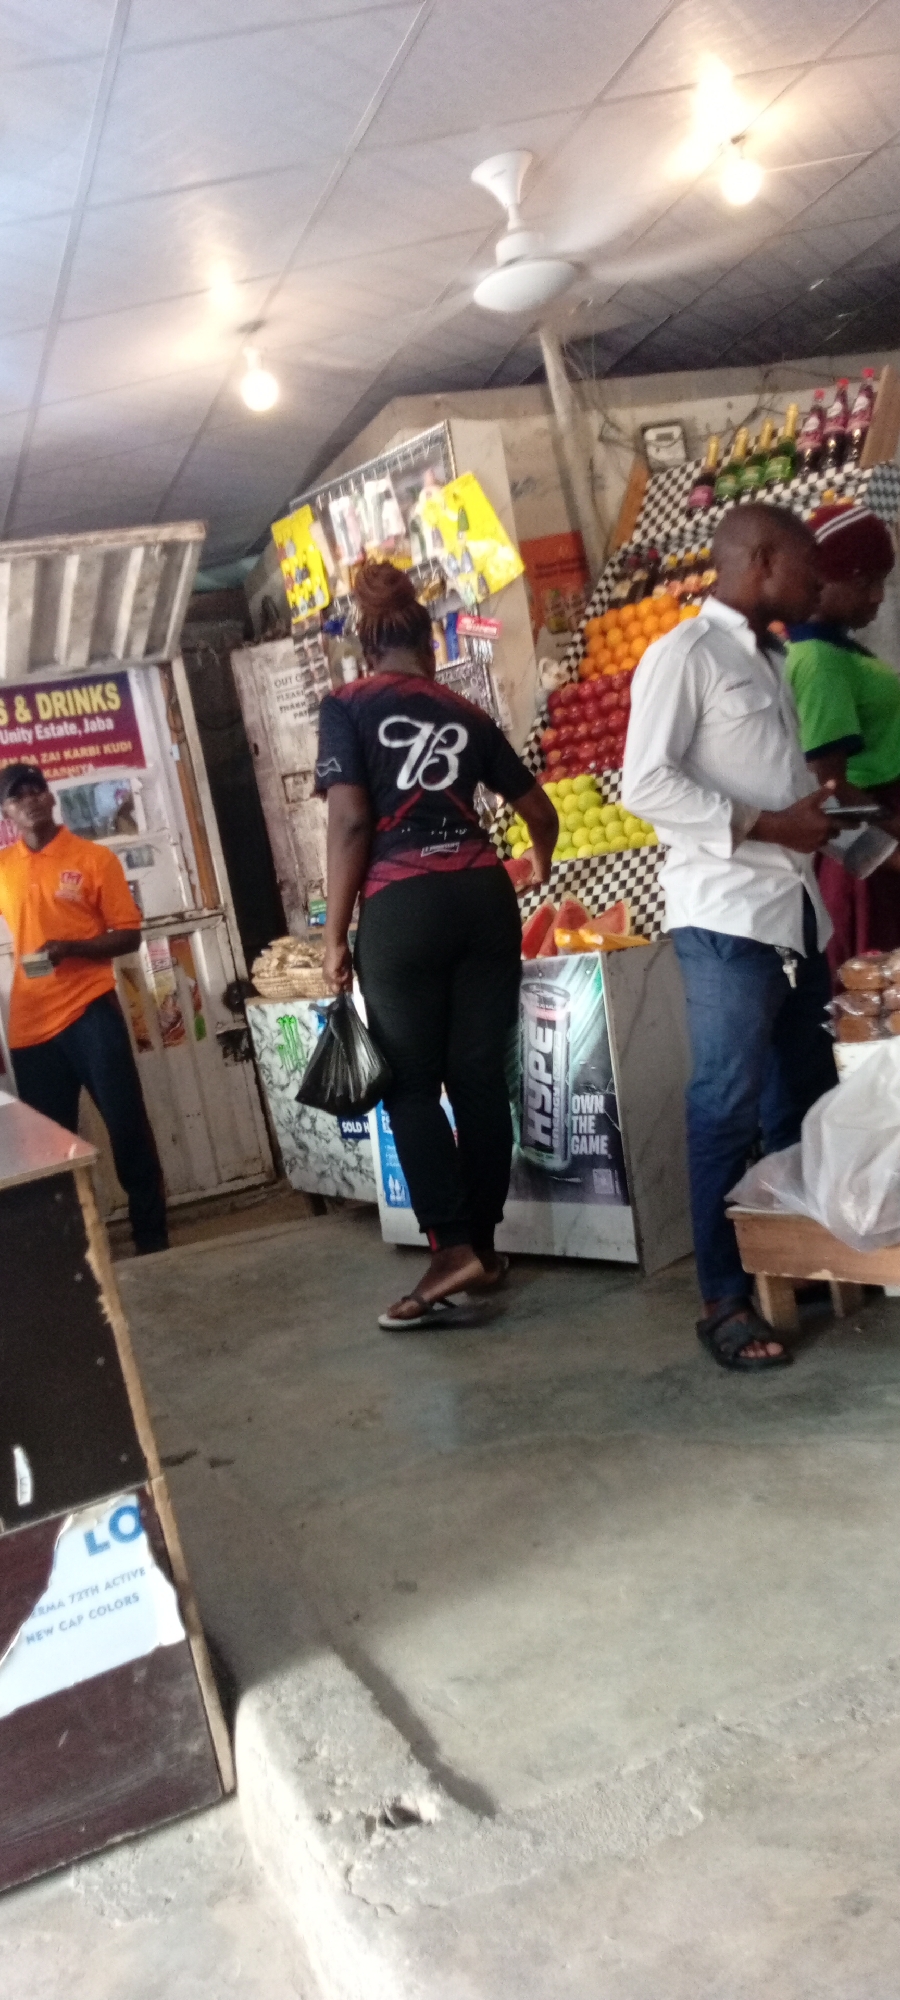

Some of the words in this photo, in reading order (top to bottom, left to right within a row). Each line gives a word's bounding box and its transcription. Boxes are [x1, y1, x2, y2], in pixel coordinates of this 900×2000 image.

[14, 694, 32, 724] &
[35, 682, 121, 721] DRINKS
[0, 728, 33, 745] Unity
[34, 721, 82, 740] Estate,
[83, 717, 114, 734] Jaba
[40, 751, 61, 763] ZAI
[102, 740, 133, 755] KUDI
[527, 1021, 553, 1147] HYPE
[571, 1095, 604, 1114] OWN
[342, 1121, 362, 1133] SOLD
[572, 1115, 596, 1134] THE
[84, 1505, 145, 1556] LO
[68, 1585, 100, 1605] 72TH
[104, 1566, 147, 1592] ACTIVE
[26, 1626, 54, 1645] NEW
[59, 1614, 84, 1632] CAP
[88, 1592, 141, 1620] COLORS
